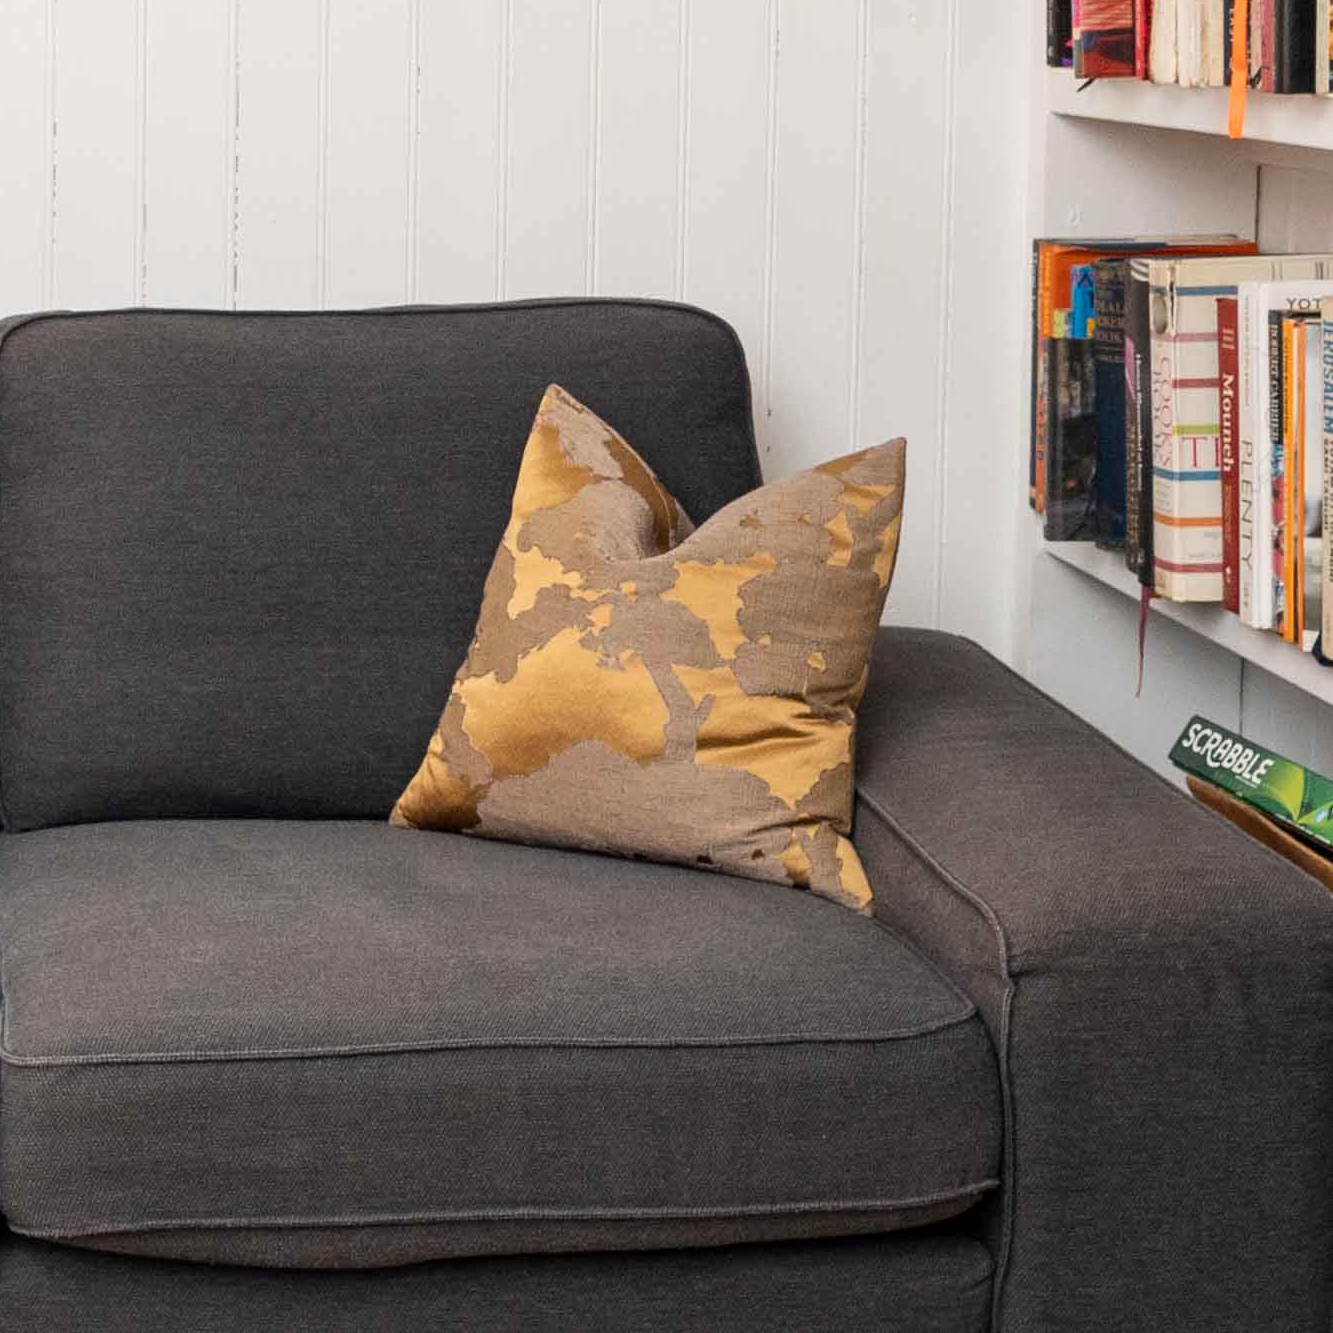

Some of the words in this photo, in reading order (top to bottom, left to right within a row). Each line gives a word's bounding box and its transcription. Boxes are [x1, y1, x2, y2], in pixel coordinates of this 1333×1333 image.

[1221, 372, 1236, 472] Mouneh
[1240, 438, 1254, 573] PLENTY
[1181, 722, 1276, 785] SCRABBLE
